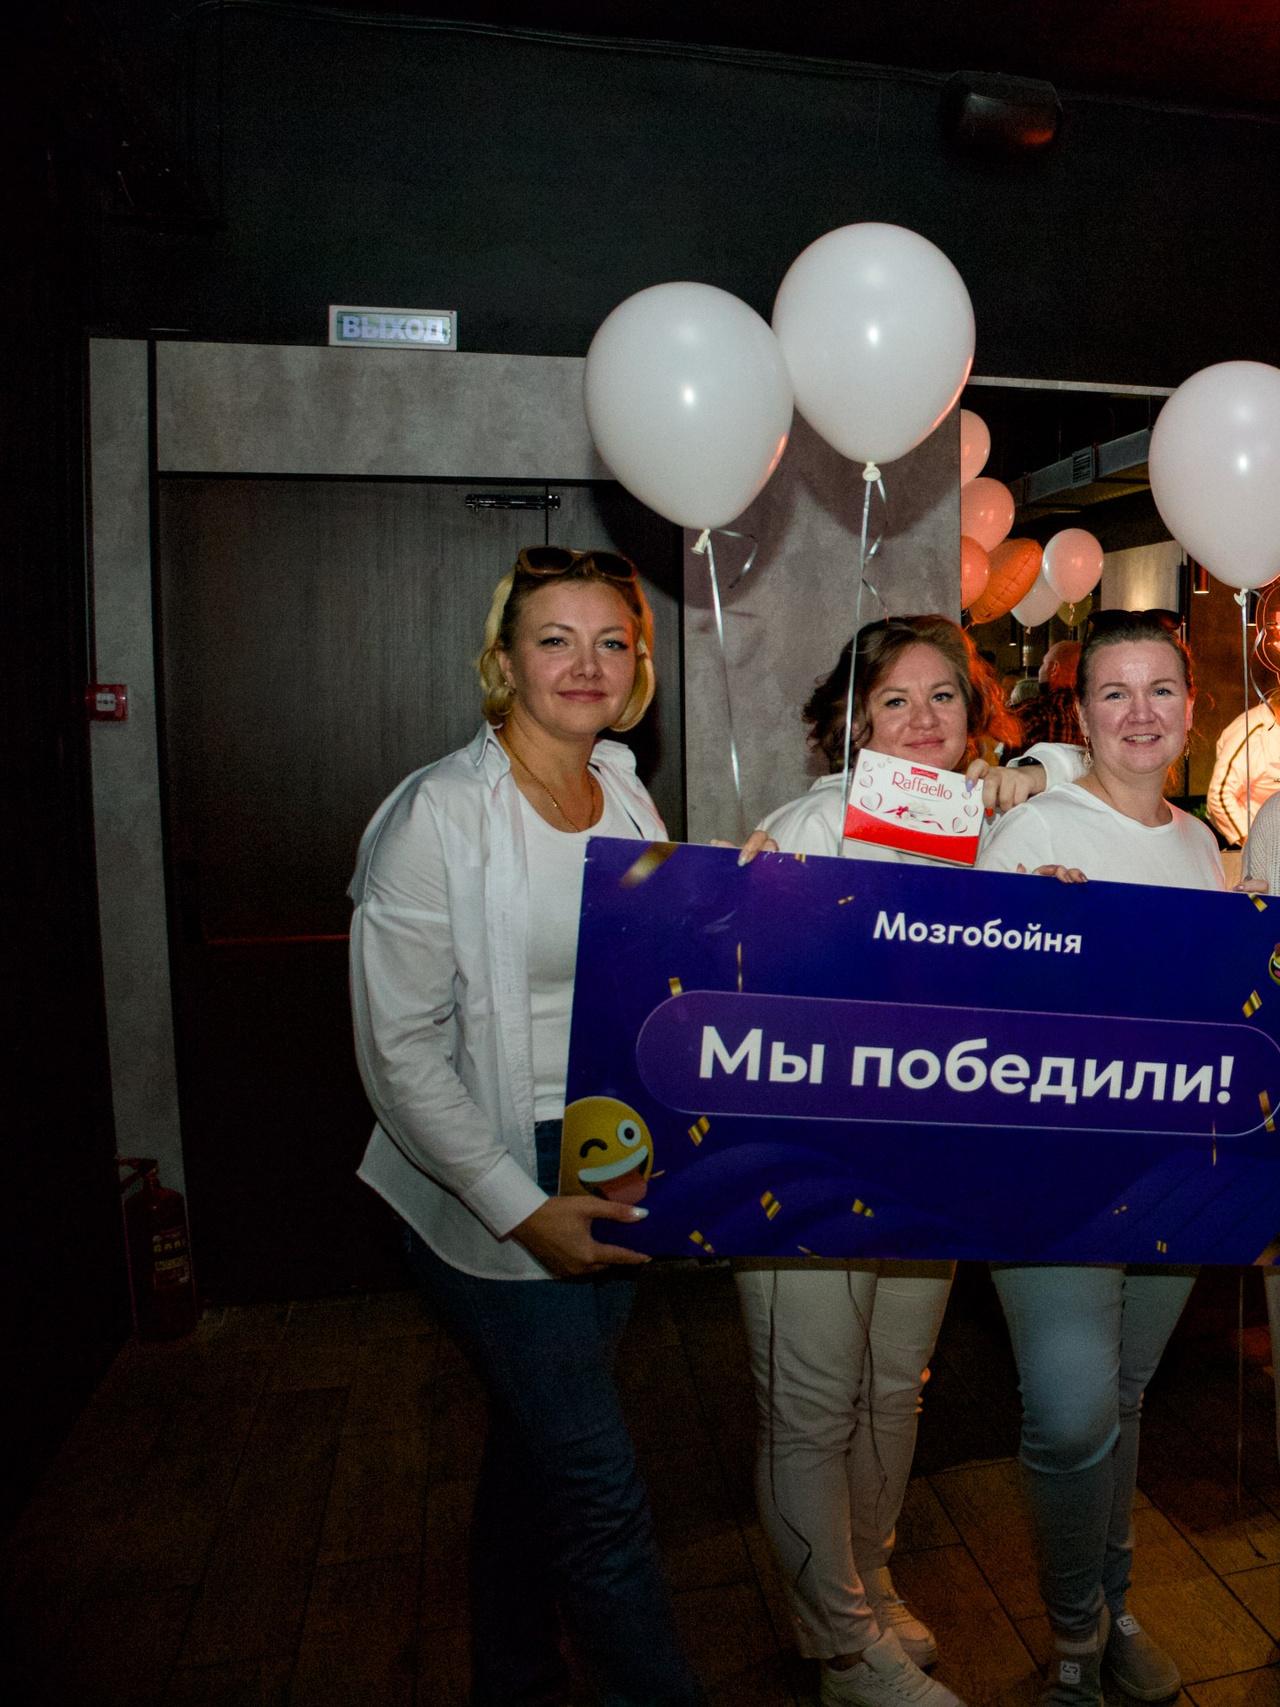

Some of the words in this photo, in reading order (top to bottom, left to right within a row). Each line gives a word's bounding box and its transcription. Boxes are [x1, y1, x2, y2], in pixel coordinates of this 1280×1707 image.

[342, 315, 445, 342] ВЫХОД
[891, 771, 953, 801] Raffaello
[872, 910, 1084, 956] Мозгобойня
[697, 1024, 824, 1085] Мы
[850, 1036, 1236, 1106] победили!
